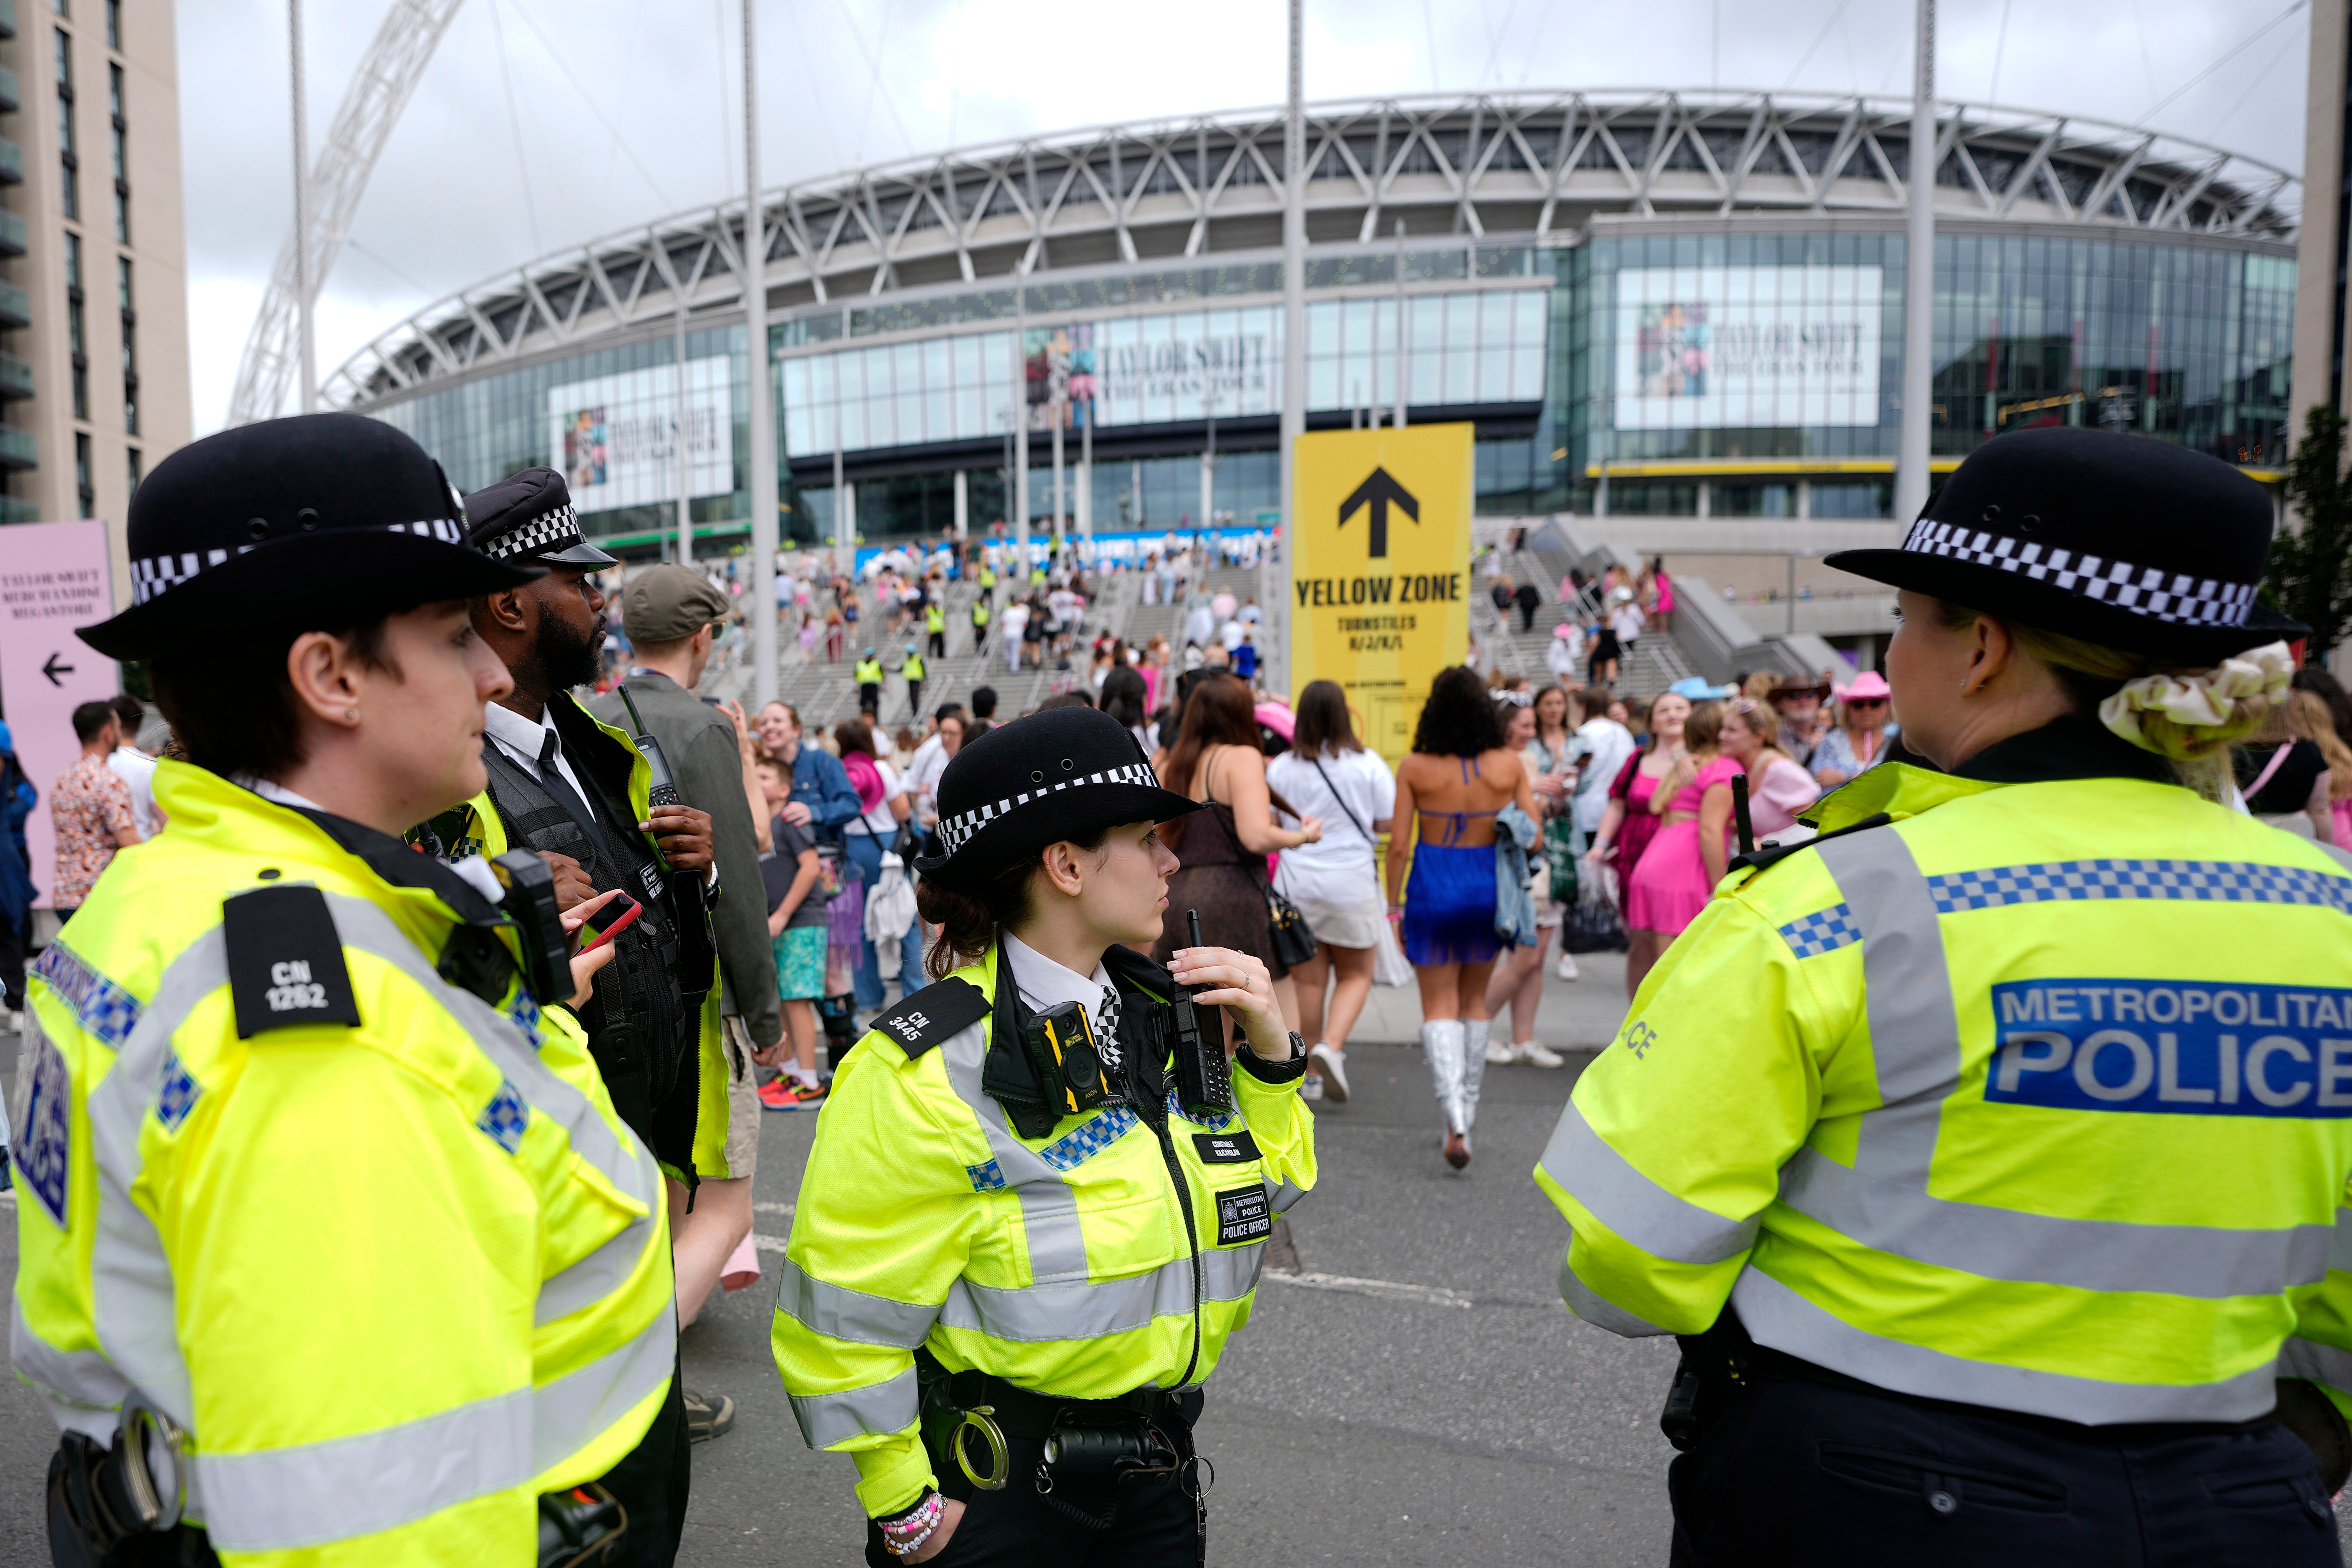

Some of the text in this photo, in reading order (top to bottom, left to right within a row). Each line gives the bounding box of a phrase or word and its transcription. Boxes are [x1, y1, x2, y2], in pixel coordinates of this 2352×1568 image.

[1296, 573, 1460, 607] YELLOW ZONE
[1337, 615, 1417, 632] TURNSTILES
[271, 960, 312, 986] CN
[1999, 987, 2352, 1030] METROPOLITA
[889, 1016, 922, 1041] 3445
[908, 1012, 930, 1029] CN
[1085, 1088, 1097, 1099] AXON
[1236, 1195, 1264, 1207] METROPOLITAN
[1242, 1206, 1262, 1217] POLICE
[1223, 1218, 1269, 1239] POLICE OFFICER
